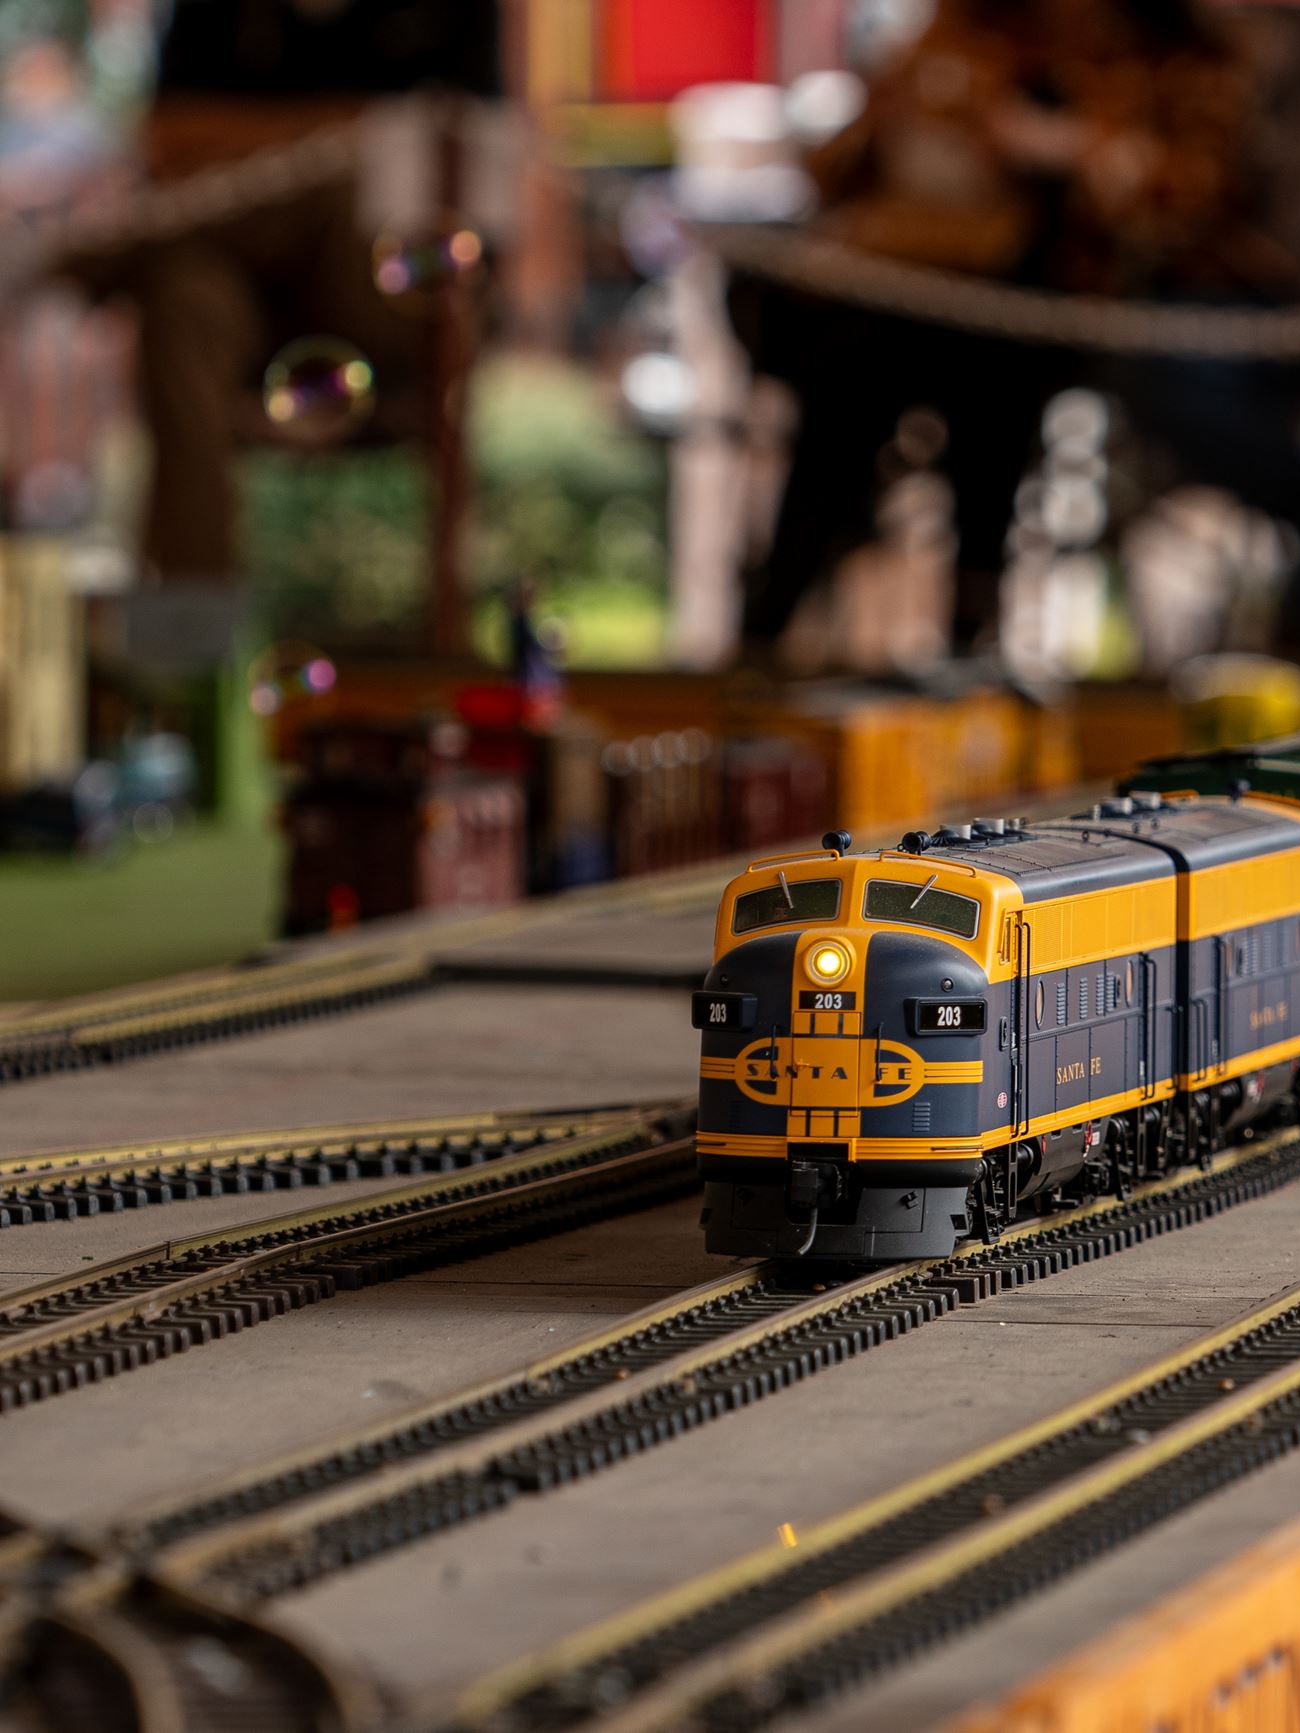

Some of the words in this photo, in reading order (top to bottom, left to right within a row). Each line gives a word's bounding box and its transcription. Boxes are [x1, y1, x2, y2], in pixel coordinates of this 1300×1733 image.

[814, 993, 842, 1009] 203
[709, 1003, 727, 1023] 203
[937, 1006, 961, 1026] 203
[746, 1063, 848, 1080] SANTA
[879, 1067, 912, 1081] FE
[1056, 1061, 1085, 1085] SANTA
[1090, 1056, 1101, 1075] FE
